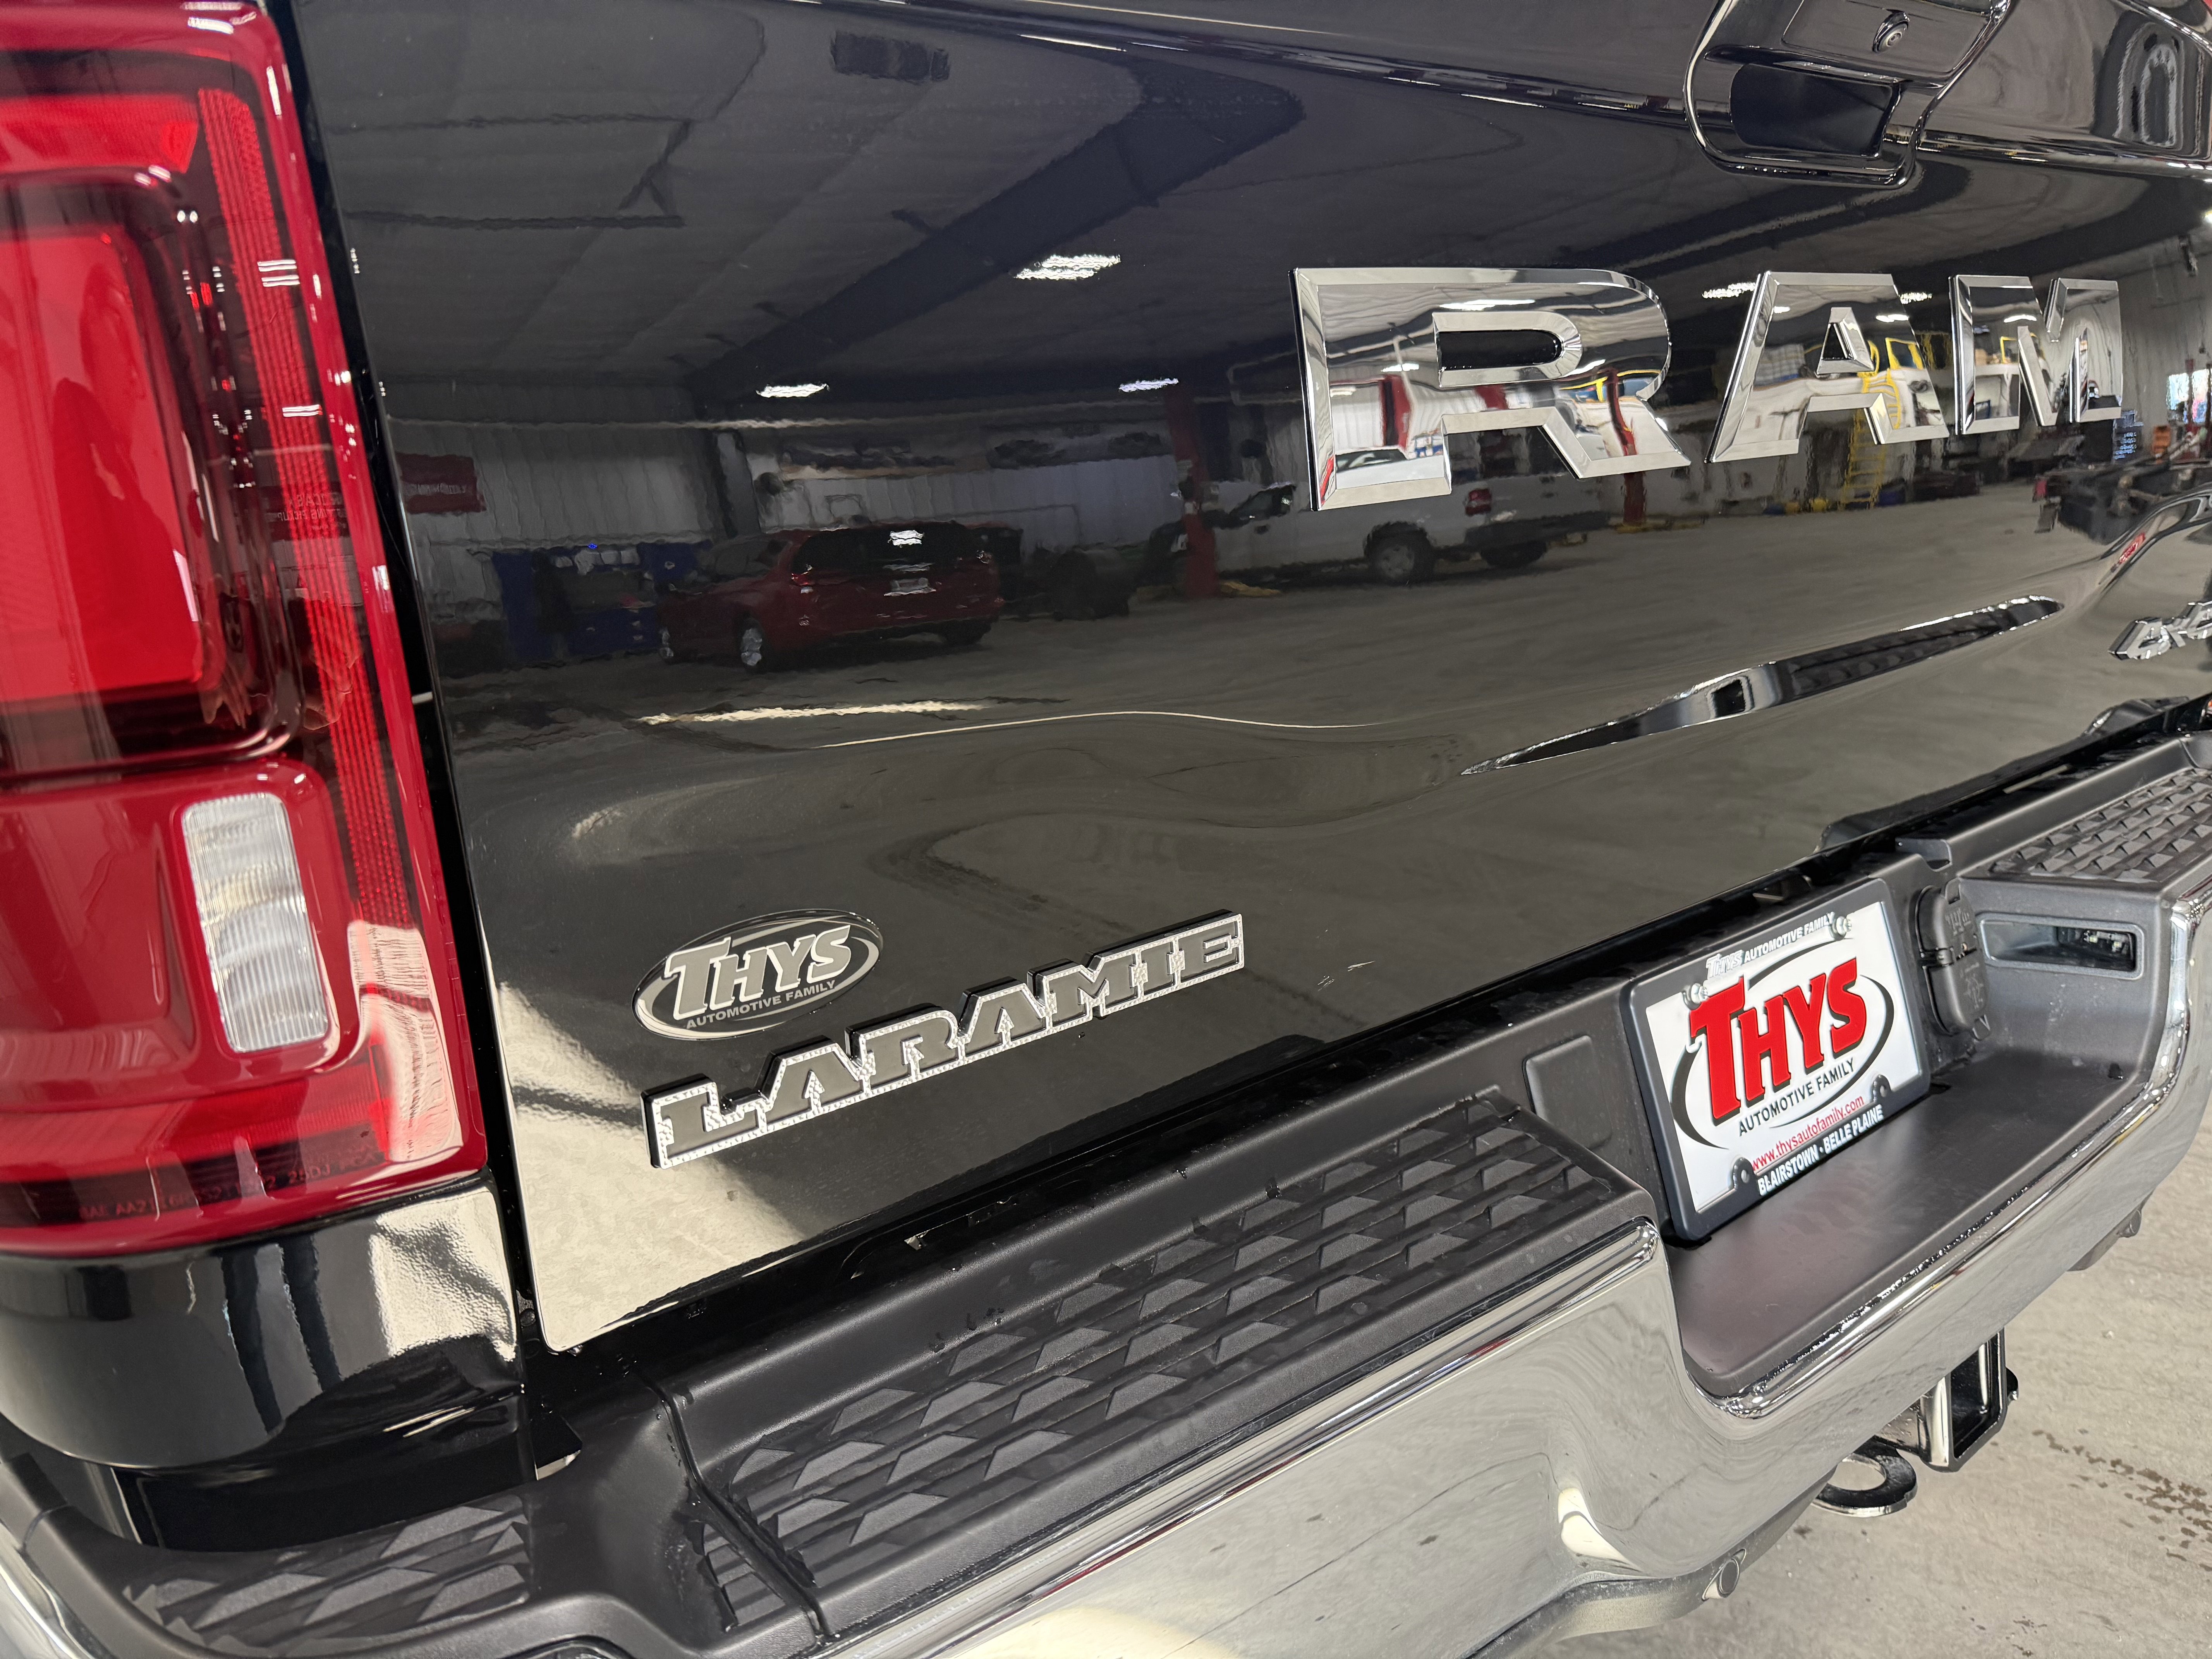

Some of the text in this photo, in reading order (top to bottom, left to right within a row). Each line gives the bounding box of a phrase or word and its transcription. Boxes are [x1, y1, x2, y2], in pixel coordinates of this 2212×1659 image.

[1290, 266, 2123, 512] RAM
[665, 925, 852, 1020] THYS
[1705, 912, 1835, 979] THYS AUTOMOTIVE FAMILY
[642, 910, 1244, 1168] LARAMIE
[687, 980, 836, 1029] AUTOMOTIVE FAMILY
[1690, 957, 1867, 1127] THYS
[1739, 1057, 1855, 1137] AUTOMOTIVE FAMILY
[1752, 1096, 1865, 1171] www.thysautofamily.com
[1757, 1104, 1884, 1196] BLAIRSTOWN BELLE PLAINE
